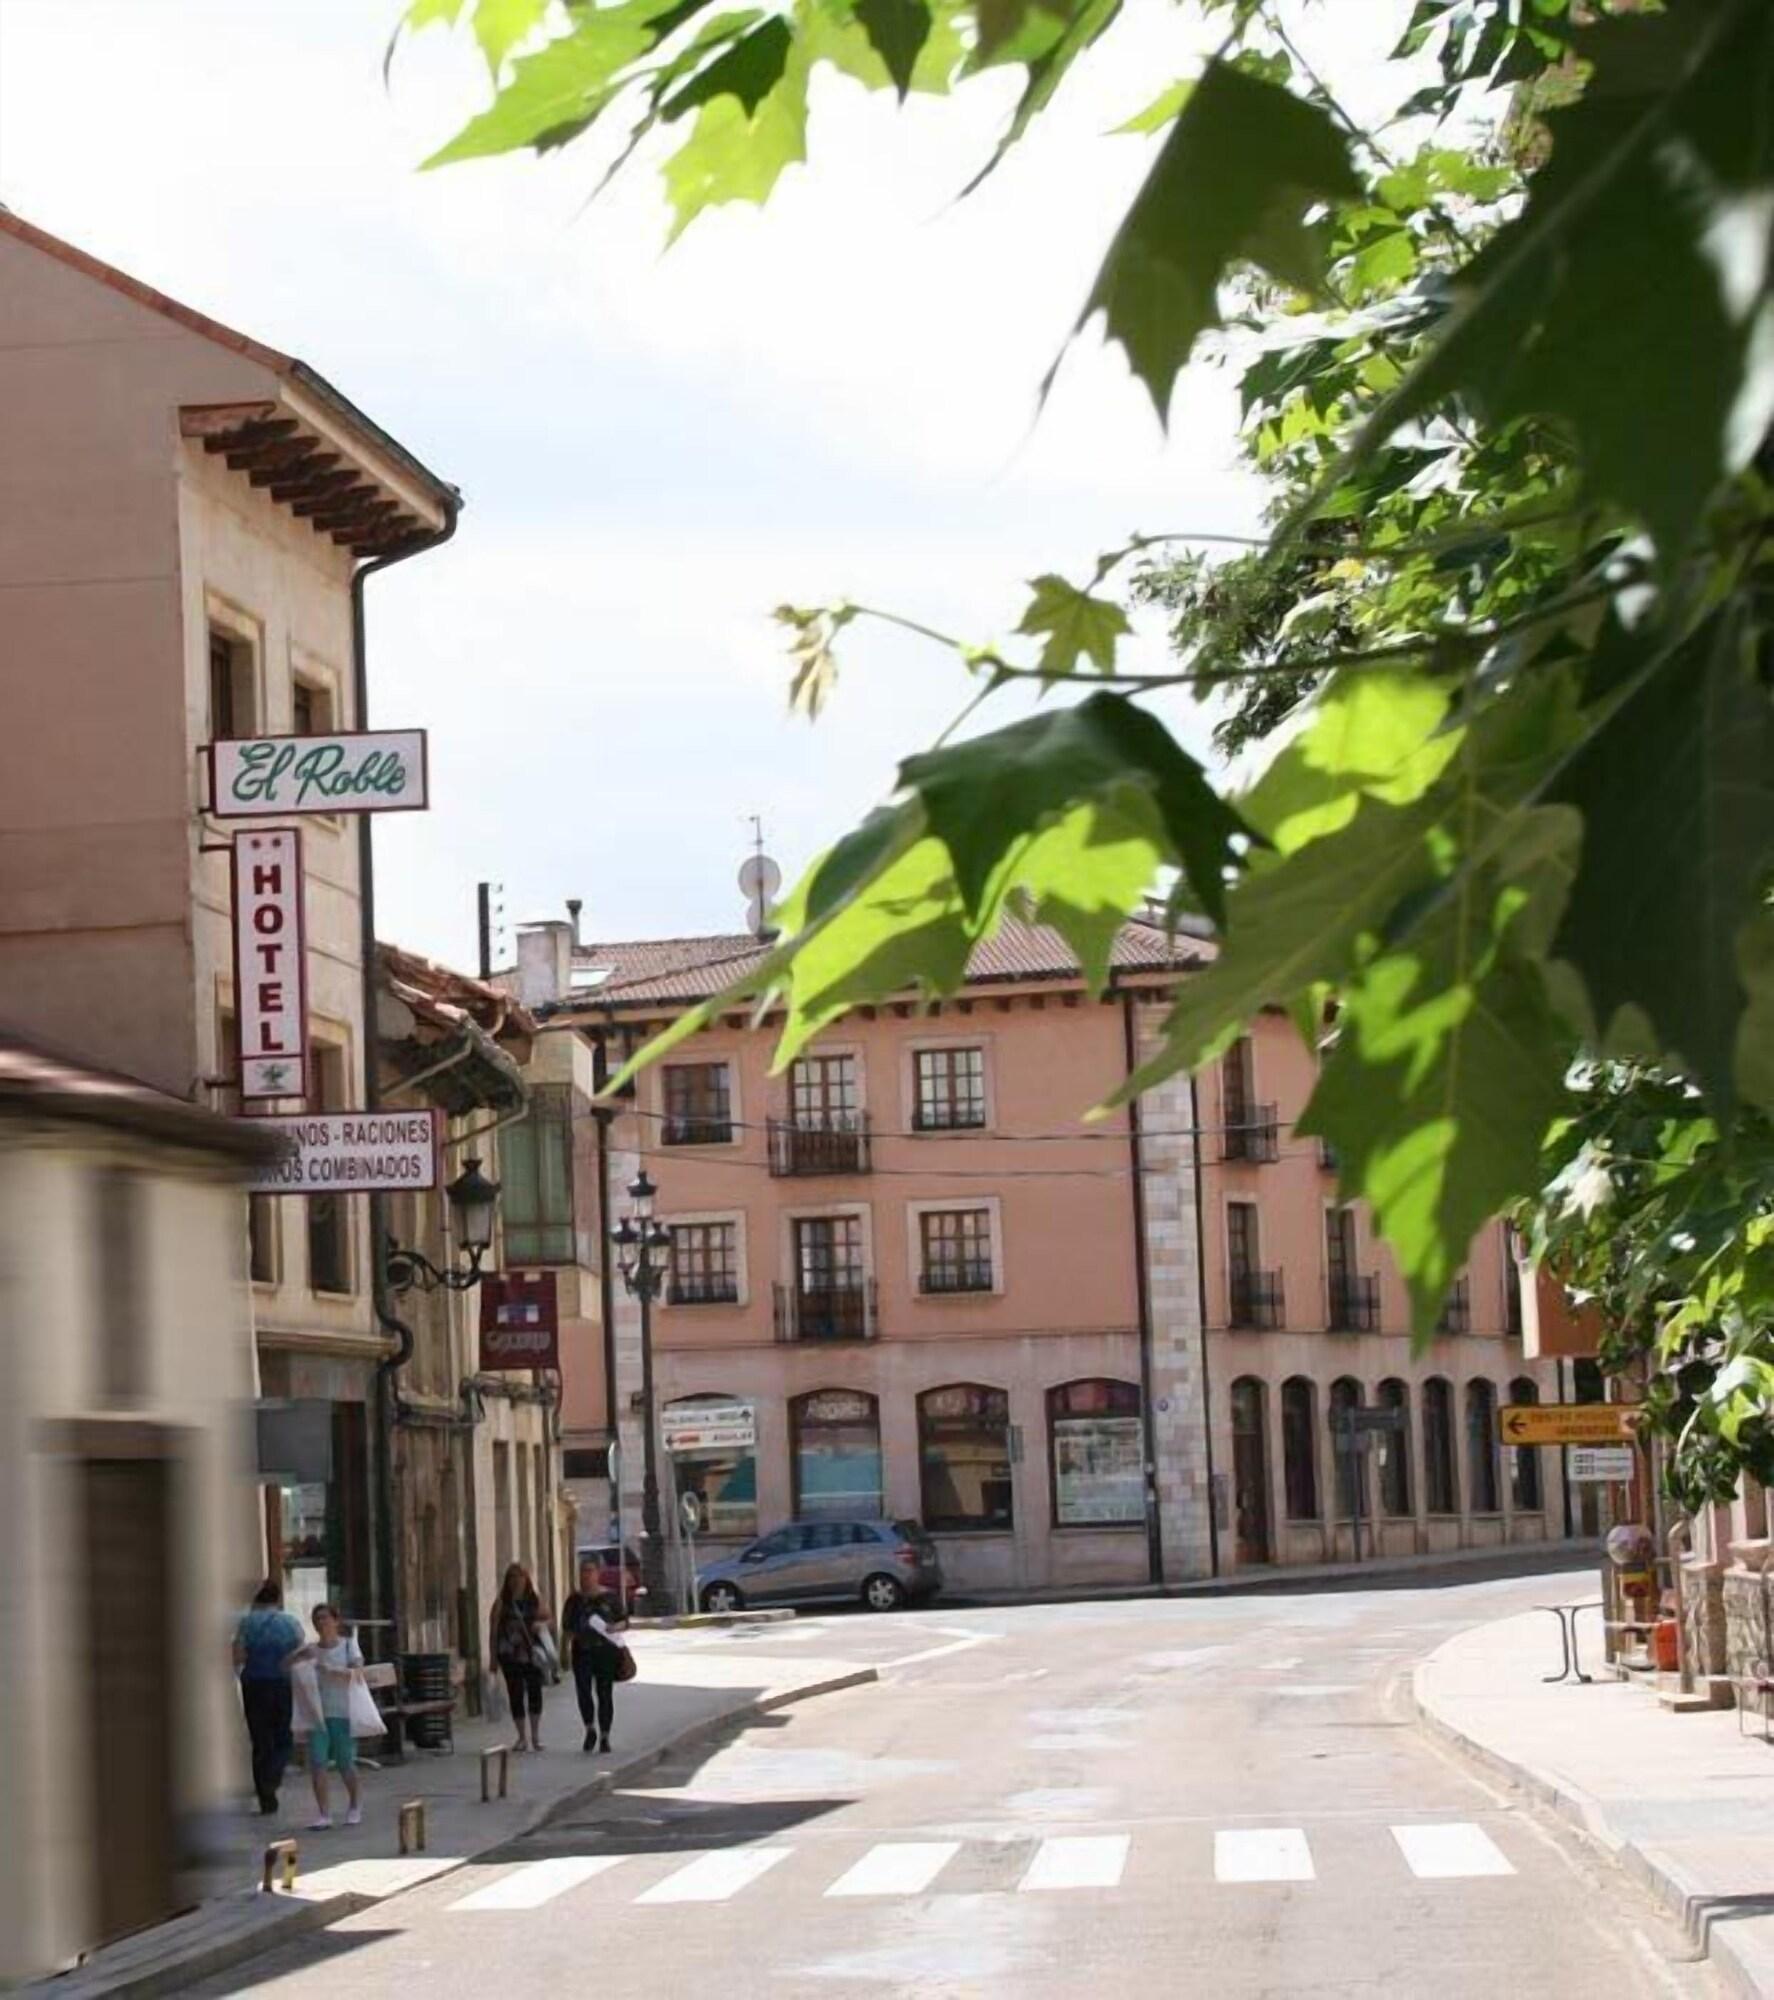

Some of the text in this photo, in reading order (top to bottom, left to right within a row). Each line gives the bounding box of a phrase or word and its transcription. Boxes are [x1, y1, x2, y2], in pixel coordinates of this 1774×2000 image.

[232, 742, 406, 805] El Roble
[253, 864, 284, 1052] HOTEL
[343, 1119, 430, 1146] RACIONES
[308, 1154, 422, 1182] COMBINADOS
